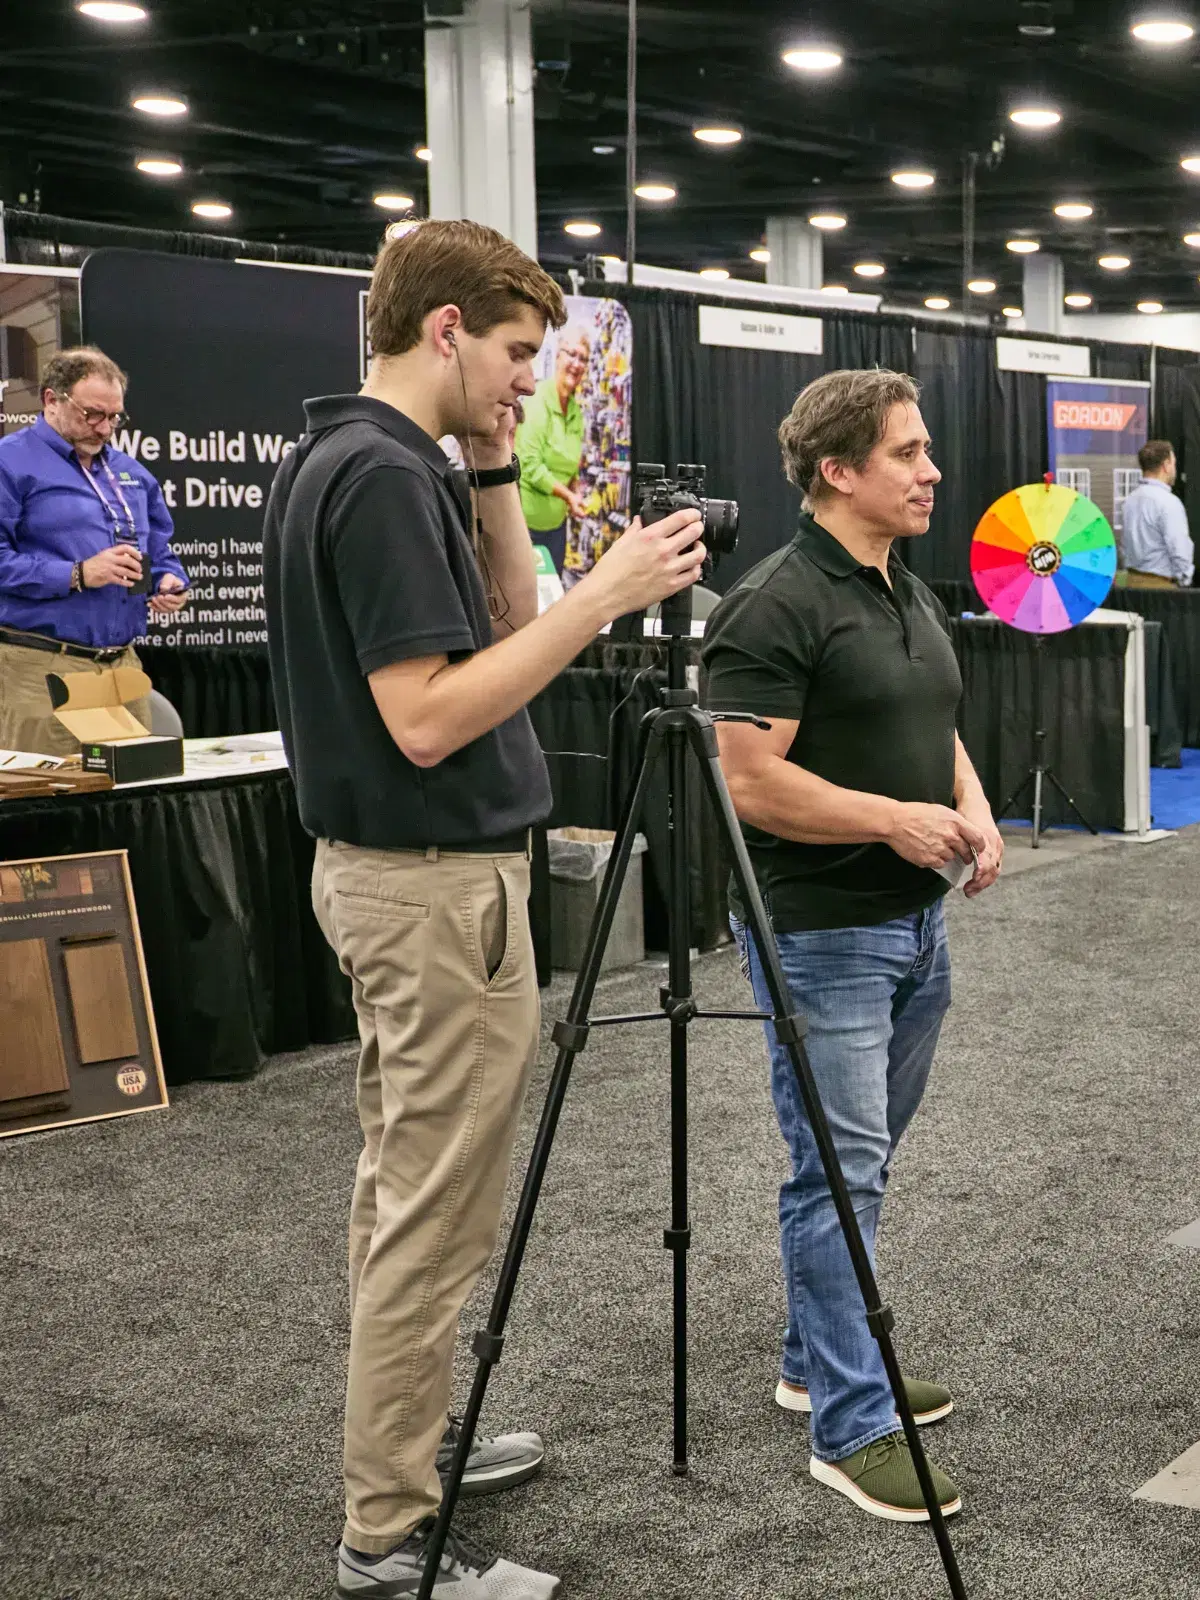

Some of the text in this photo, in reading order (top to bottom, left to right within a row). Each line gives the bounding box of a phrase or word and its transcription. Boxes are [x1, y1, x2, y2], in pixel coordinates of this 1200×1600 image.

[0, 413, 38, 424] DWOO
[1056, 404, 1124, 426] GORDON
[110, 429, 306, 463] We Build We
[185, 477, 263, 508] Drive
[221, 538, 226, 555] I
[230, 537, 263, 555] have
[187, 560, 219, 578] who
[222, 561, 234, 577] is
[187, 583, 215, 600] and
[147, 605, 268, 628] digital marketin
[133, 628, 269, 646] ace of mind I neve
[32, 908, 66, 919] MODIFIED
[123, 1075, 141, 1087] USA
